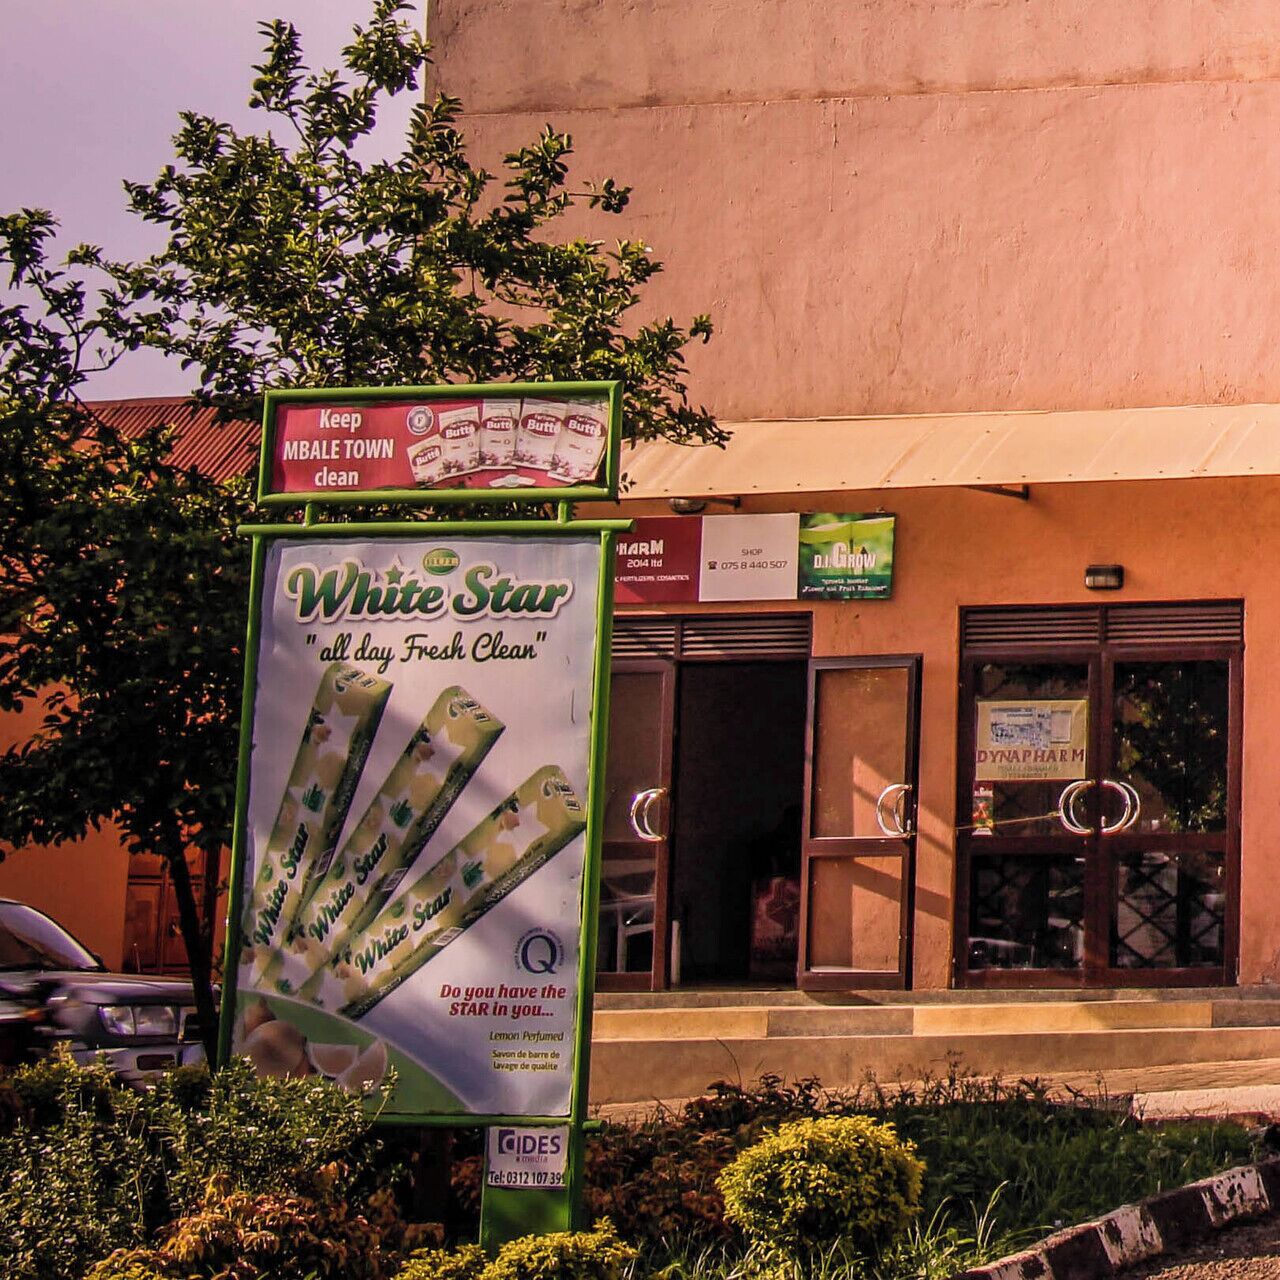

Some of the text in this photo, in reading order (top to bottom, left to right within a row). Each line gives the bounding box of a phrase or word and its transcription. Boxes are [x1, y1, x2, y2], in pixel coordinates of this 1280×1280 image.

[320, 409, 362, 433] Keep
[283, 438, 394, 461] MBALE TOWN
[314, 466, 359, 487] clean
[741, 548, 763, 556] SHOP
[627, 558, 663, 568] 2014 ltd
[721, 561, 739, 570] 075
[749, 561, 768, 569] 440
[770, 560, 788, 569] 507
[288, 561, 569, 618] White Star
[354, 632, 395, 674] day
[400, 631, 465, 663] Fresh
[977, 749, 1085, 763] DYNAPHARM
[253, 822, 310, 946] White Star
[309, 832, 389, 942] White Star
[354, 886, 453, 976] White Star
[521, 935, 557, 974] Q
[440, 984, 567, 1001] Do you have the
[449, 1001, 554, 1020] STAR in you...
[490, 1030, 565, 1043] Lemon Perfumed
[492, 1050, 560, 1059] Savon de barre de
[521, 1062, 530, 1070] de
[489, 1170, 505, 1184] Tel:
[507, 1171, 530, 1184] 0312
[532, 1172, 549, 1185] 107
